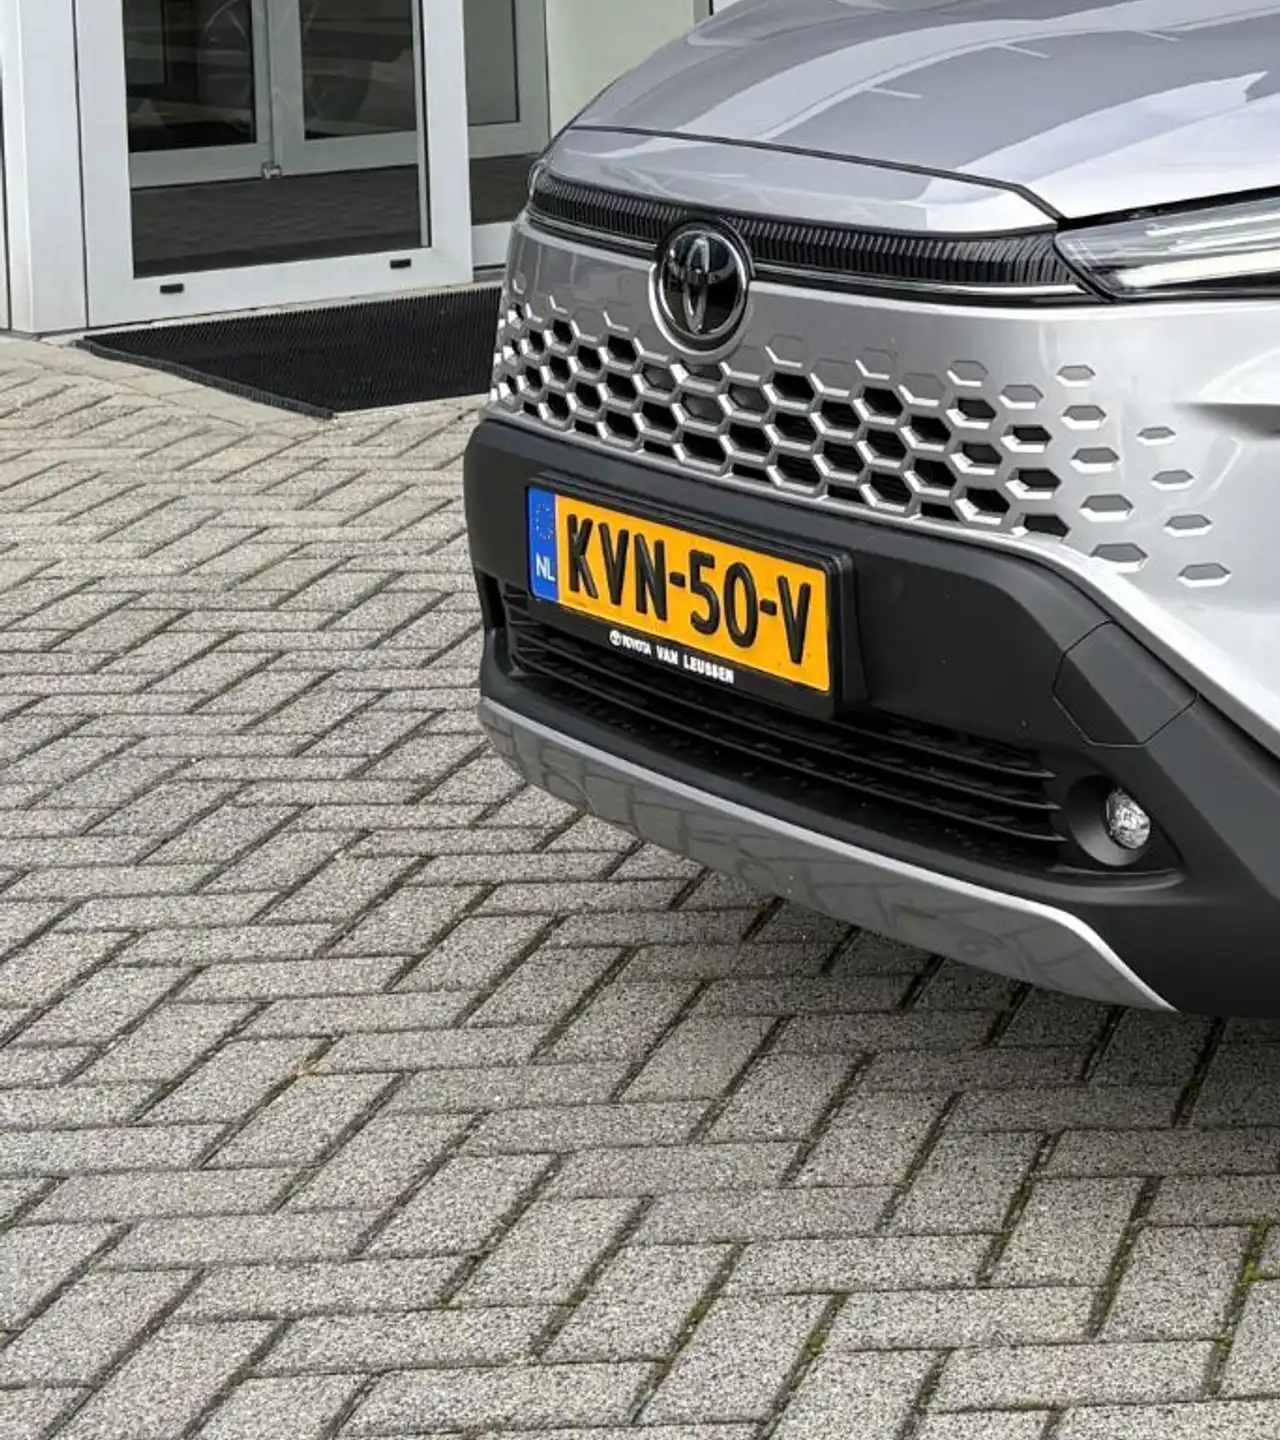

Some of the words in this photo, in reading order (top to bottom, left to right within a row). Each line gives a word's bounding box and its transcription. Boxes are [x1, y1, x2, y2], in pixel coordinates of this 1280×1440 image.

[535, 553, 557, 582] NL
[565, 513, 813, 665] KVN-50-V
[621, 633, 652, 656] TOYOTA
[656, 645, 679, 666] VAN
[682, 653, 735, 685] LEUSSEN
